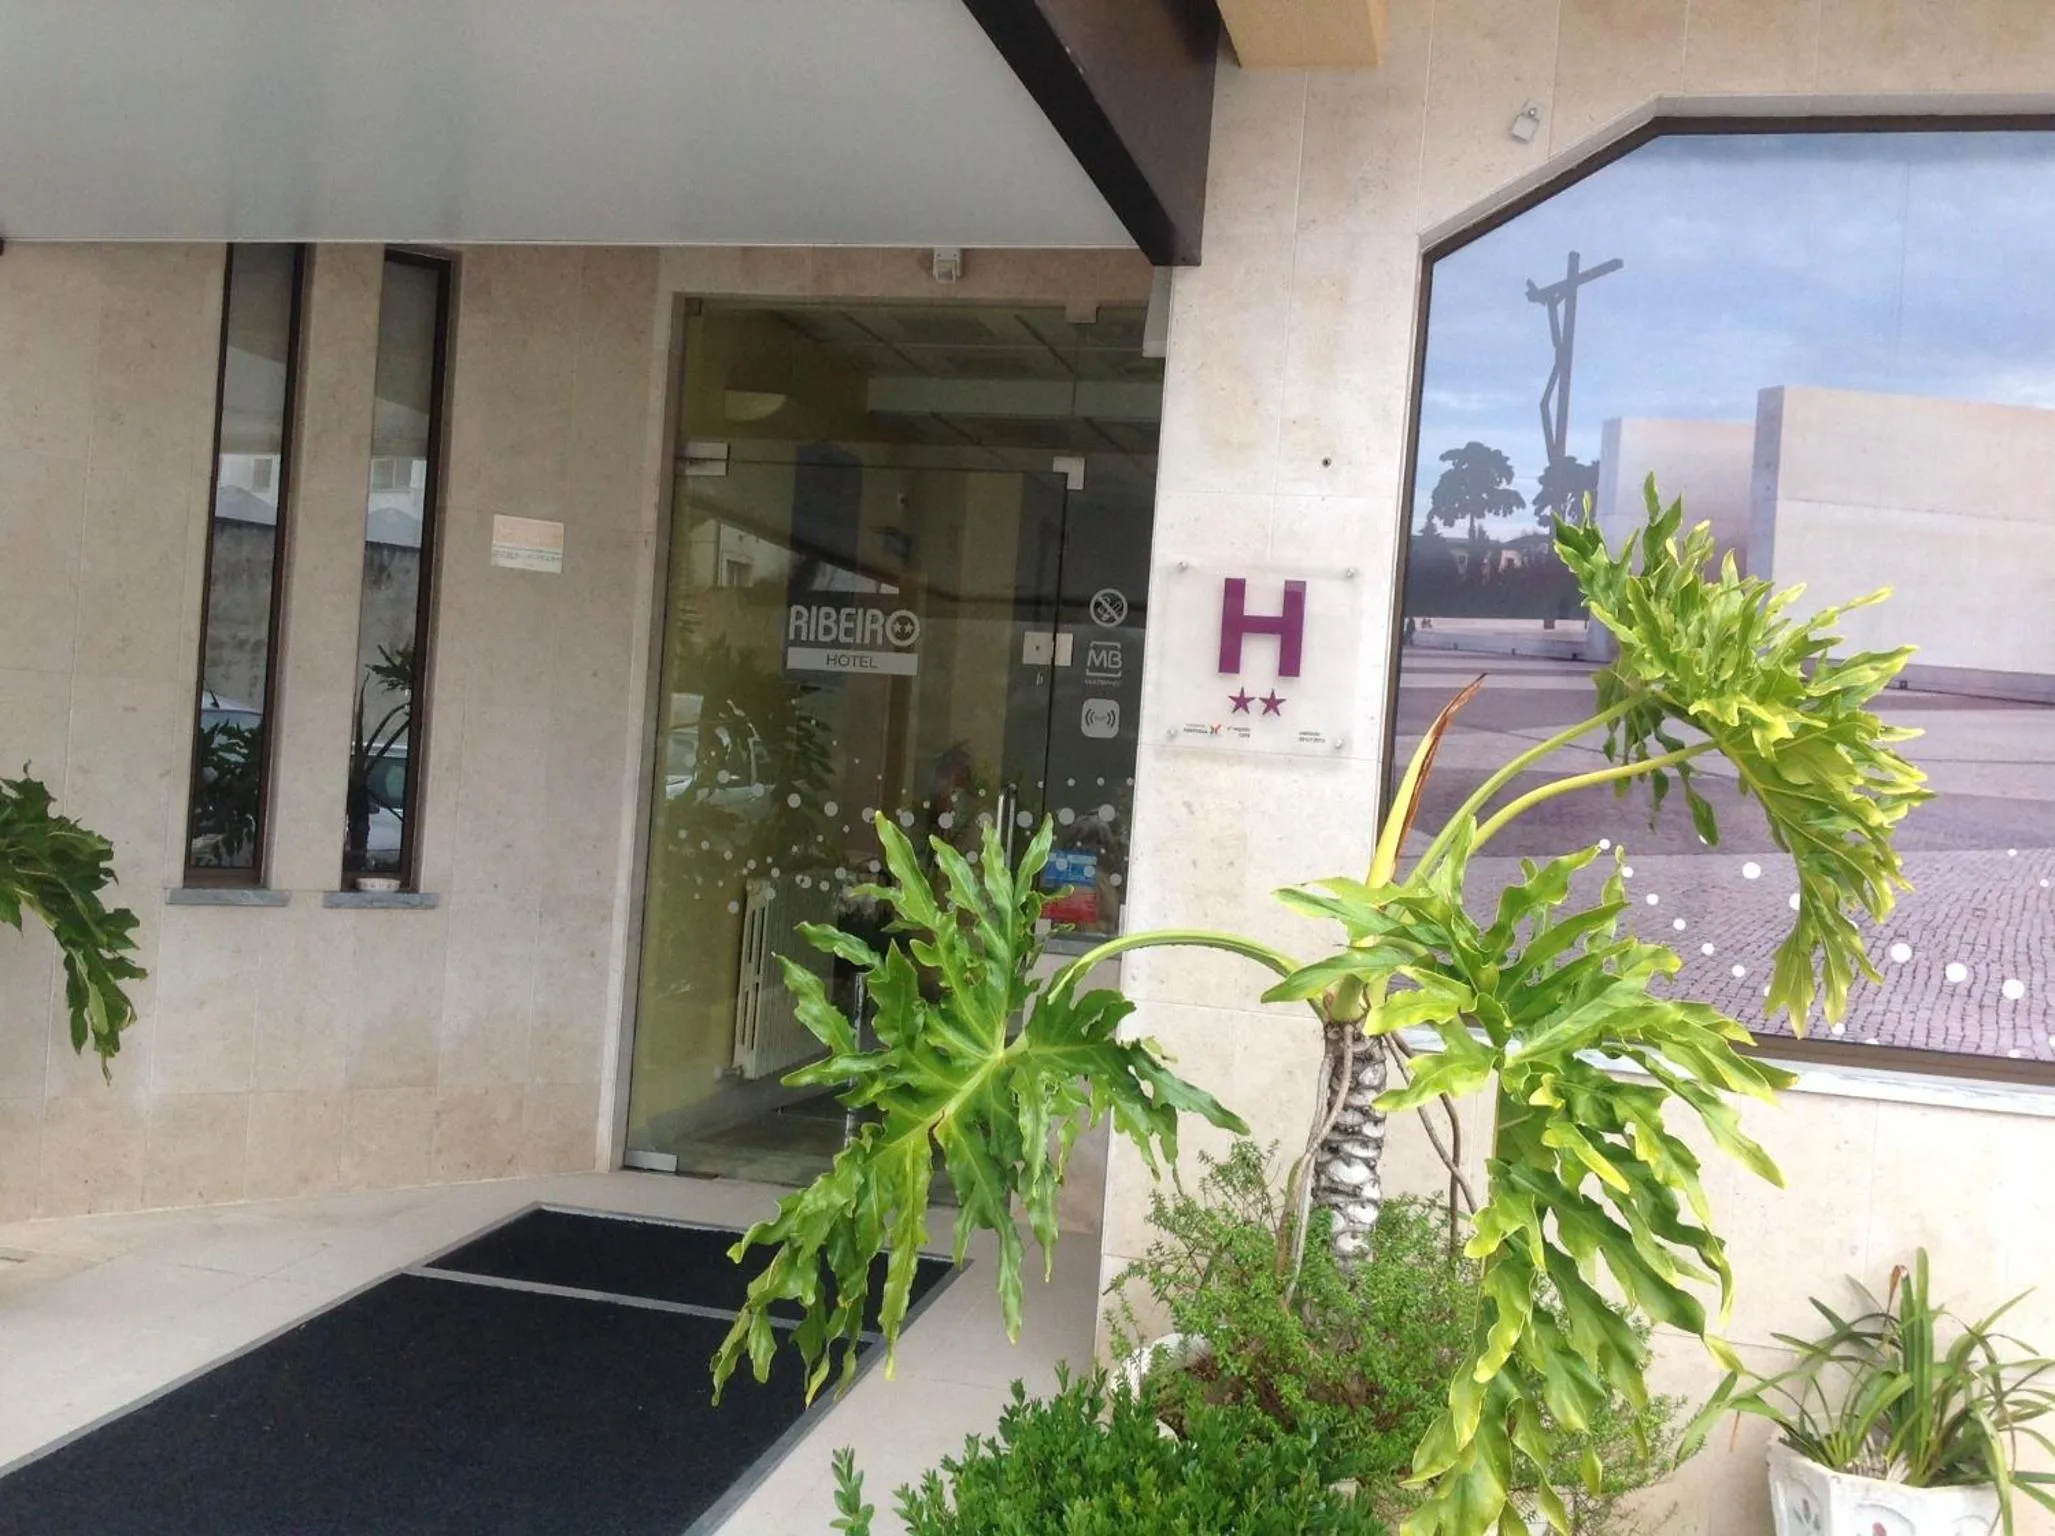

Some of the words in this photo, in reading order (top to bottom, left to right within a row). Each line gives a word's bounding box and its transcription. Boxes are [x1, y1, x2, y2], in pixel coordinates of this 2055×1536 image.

[788, 604, 920, 647] RIBEIRO
[1218, 577, 1307, 678] H
[826, 654, 878, 669] HOTEL
[1087, 650, 1122, 669] MB
